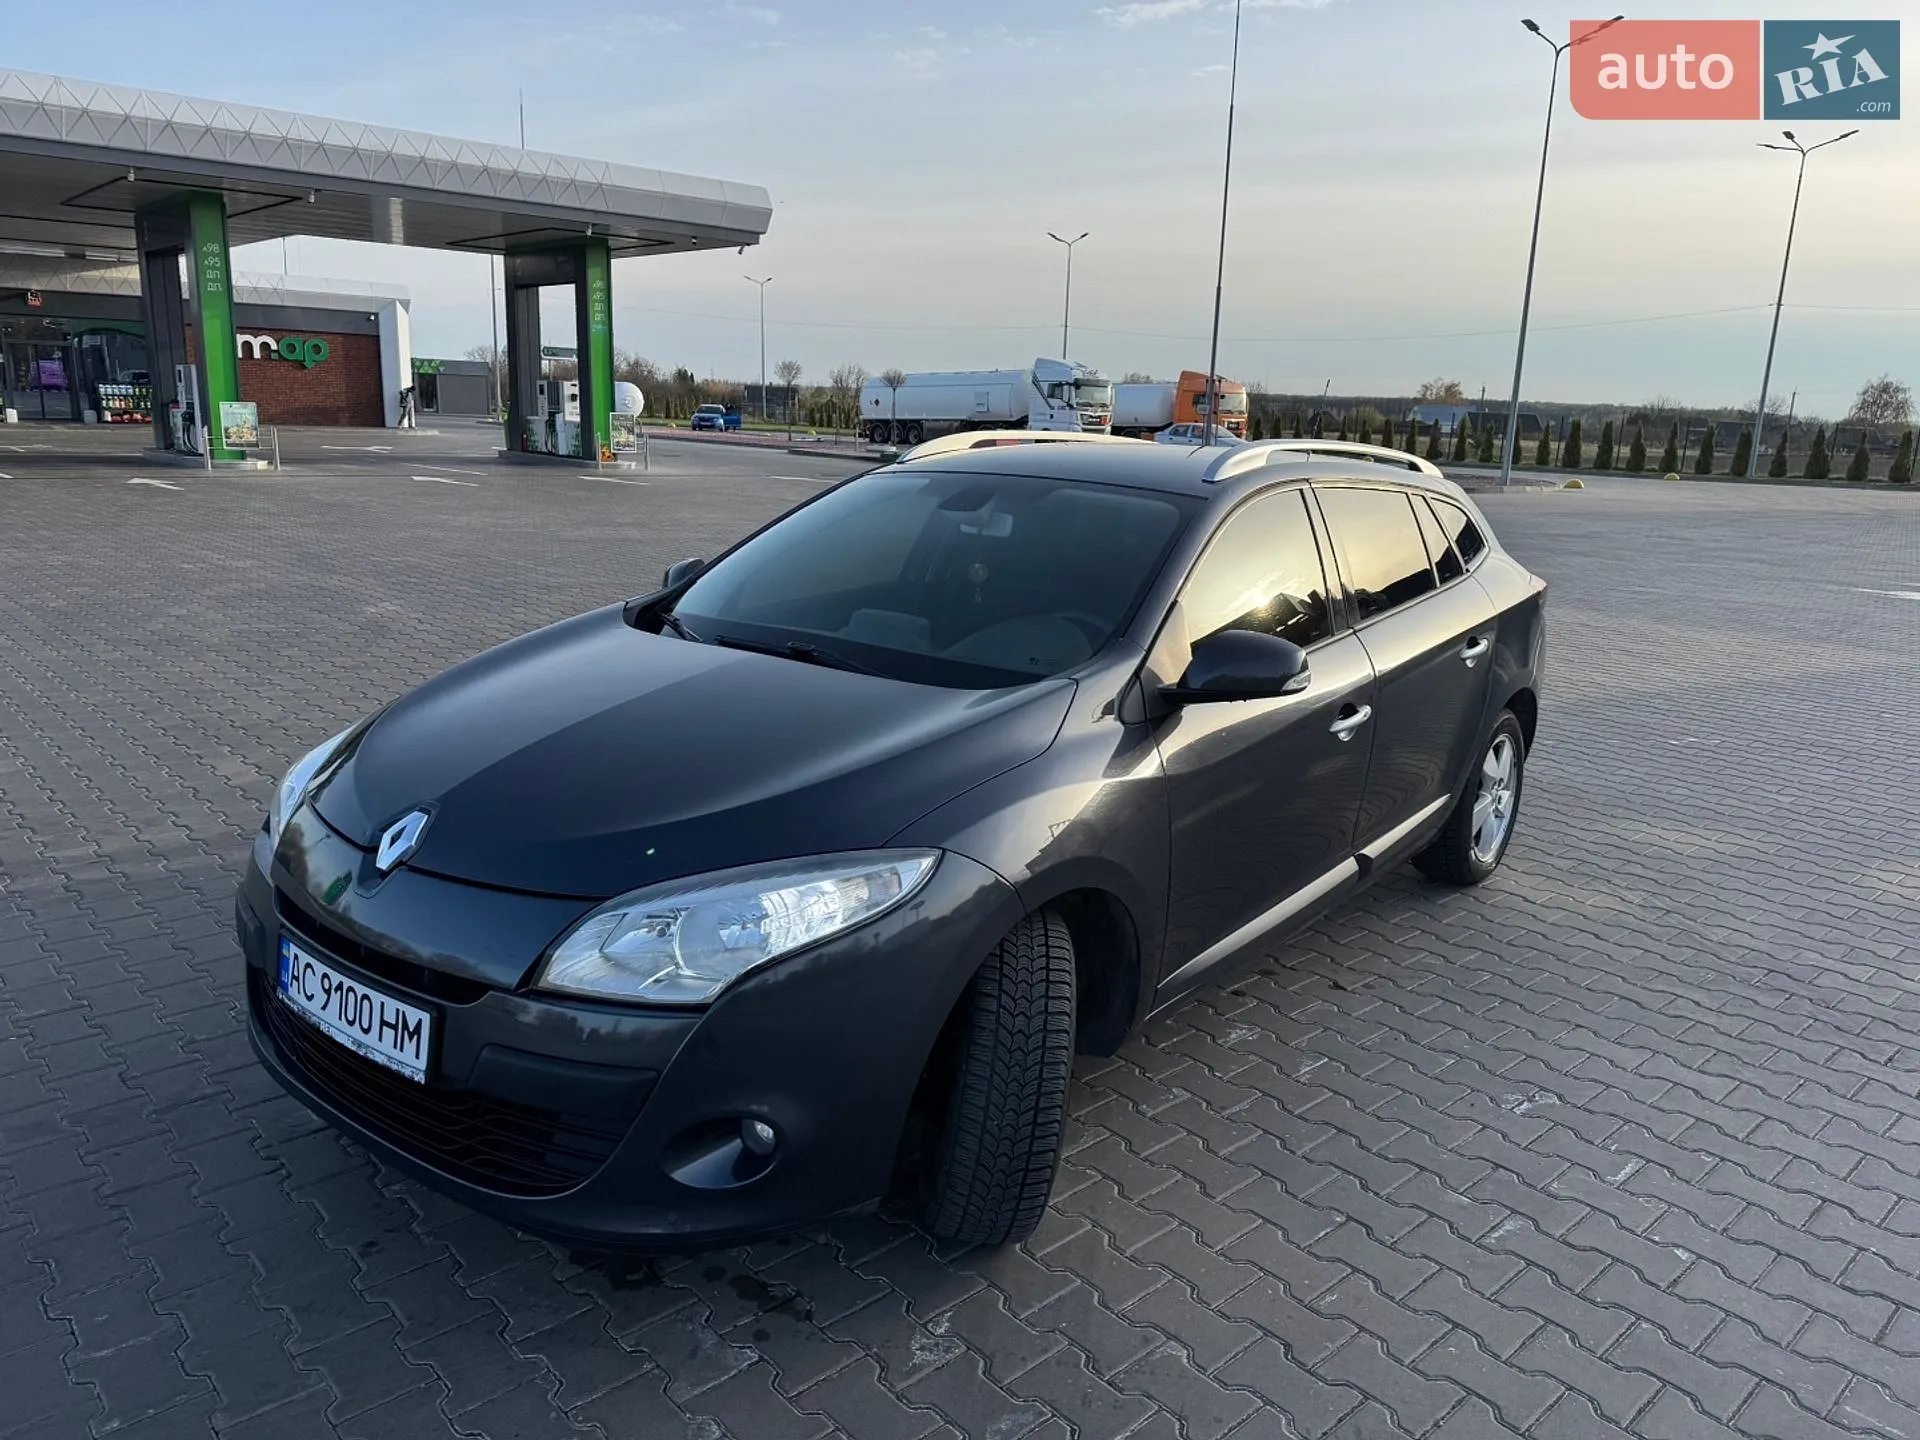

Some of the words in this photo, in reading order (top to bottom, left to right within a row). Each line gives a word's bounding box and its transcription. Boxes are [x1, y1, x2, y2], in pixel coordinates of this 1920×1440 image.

[290, 952, 316, 1002] AC
[320, 971, 373, 1035] 9100
[378, 1001, 422, 1060] HM
